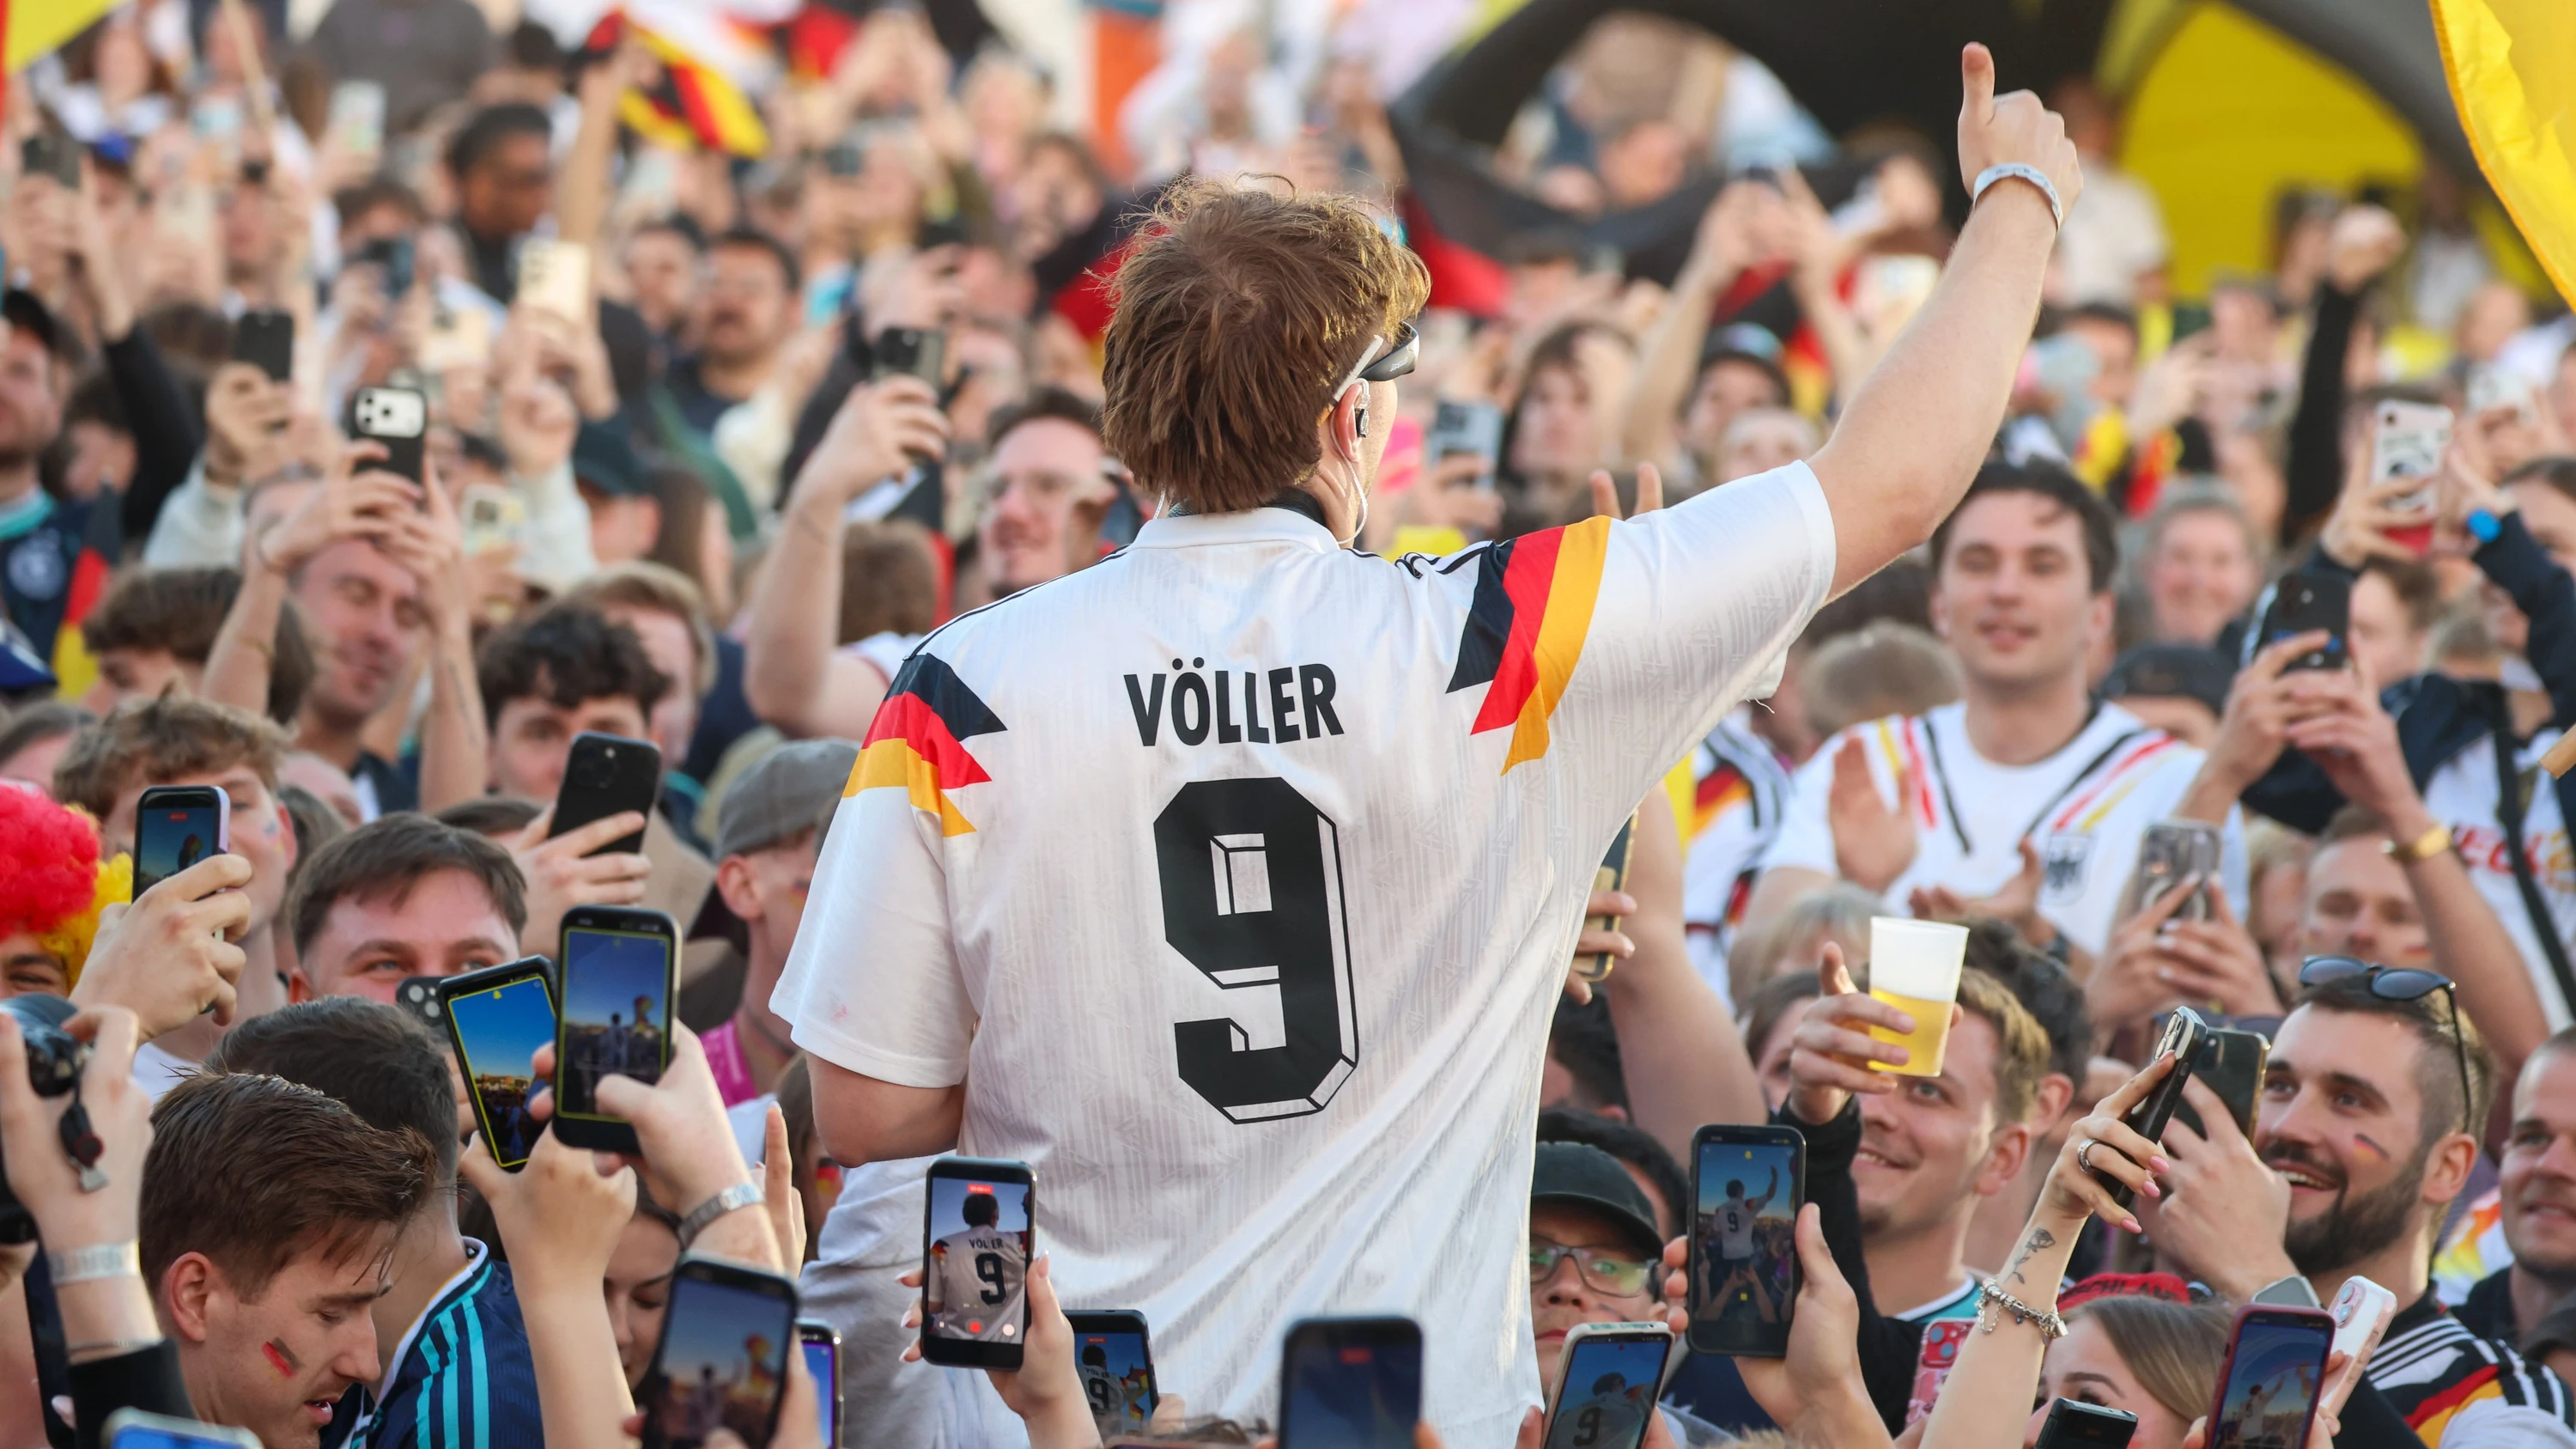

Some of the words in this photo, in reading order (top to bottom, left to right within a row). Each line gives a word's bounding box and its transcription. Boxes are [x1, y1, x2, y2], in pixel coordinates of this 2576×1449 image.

[1124, 657, 1344, 746] VÖLLER
[1153, 776, 1359, 1124] 9
[1728, 1211, 1740, 1233] 9
[975, 1252, 1006, 1305] 9
[1089, 1378, 1109, 1415] 9
[1573, 1407, 1601, 1447] 9
